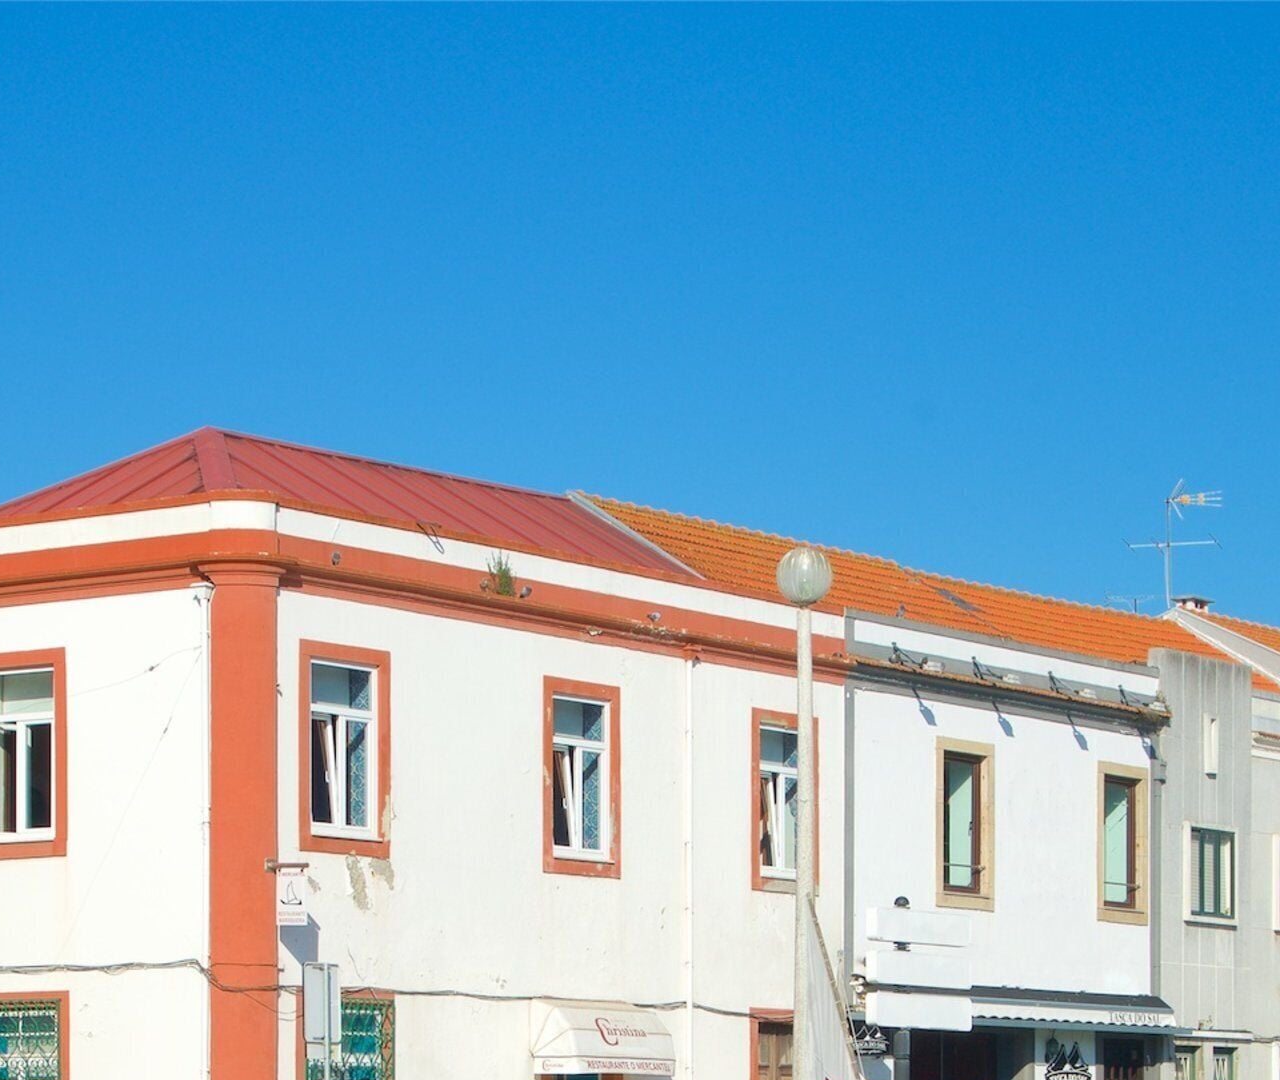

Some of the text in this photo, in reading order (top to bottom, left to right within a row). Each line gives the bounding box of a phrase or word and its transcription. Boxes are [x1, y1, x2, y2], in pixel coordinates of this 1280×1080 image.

[1109, 1011, 1161, 1024] TASCA DO SAL
[595, 1017, 647, 1046] Christina
[586, 1060, 630, 1070] RESTAURANTE
[635, 1061, 672, 1073] MERCANTEL
